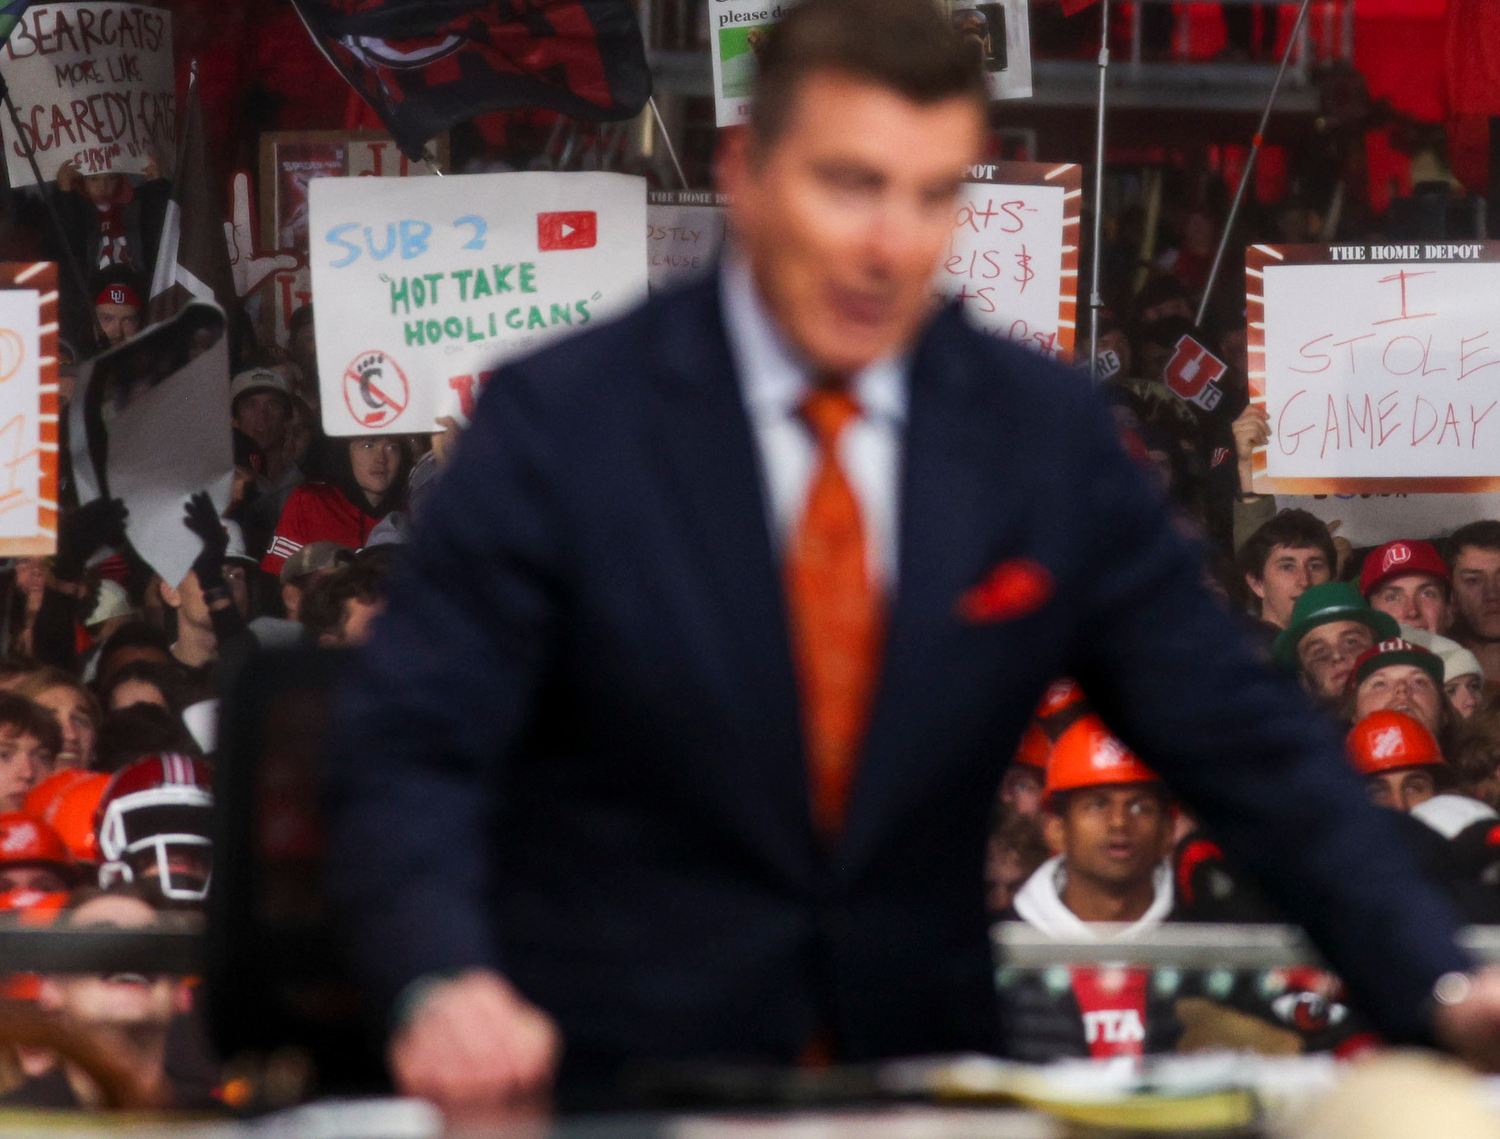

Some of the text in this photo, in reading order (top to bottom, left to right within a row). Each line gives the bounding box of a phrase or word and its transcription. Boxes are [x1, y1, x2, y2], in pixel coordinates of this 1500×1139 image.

[6, 8, 164, 60] BEARCATS?
[719, 9, 768, 27] please
[55, 54, 143, 88] MORE LIKE
[650, 190, 675, 202] THE
[678, 192, 712, 204] HOME
[325, 215, 489, 268] SUB 2
[647, 225, 702, 243] OSTLY
[1329, 244, 1484, 261] THE HOME DEPOT
[452, 261, 538, 302] TAKE
[1372, 269, 1438, 326] I
[1278, 389, 1499, 460] GAMEDAY
